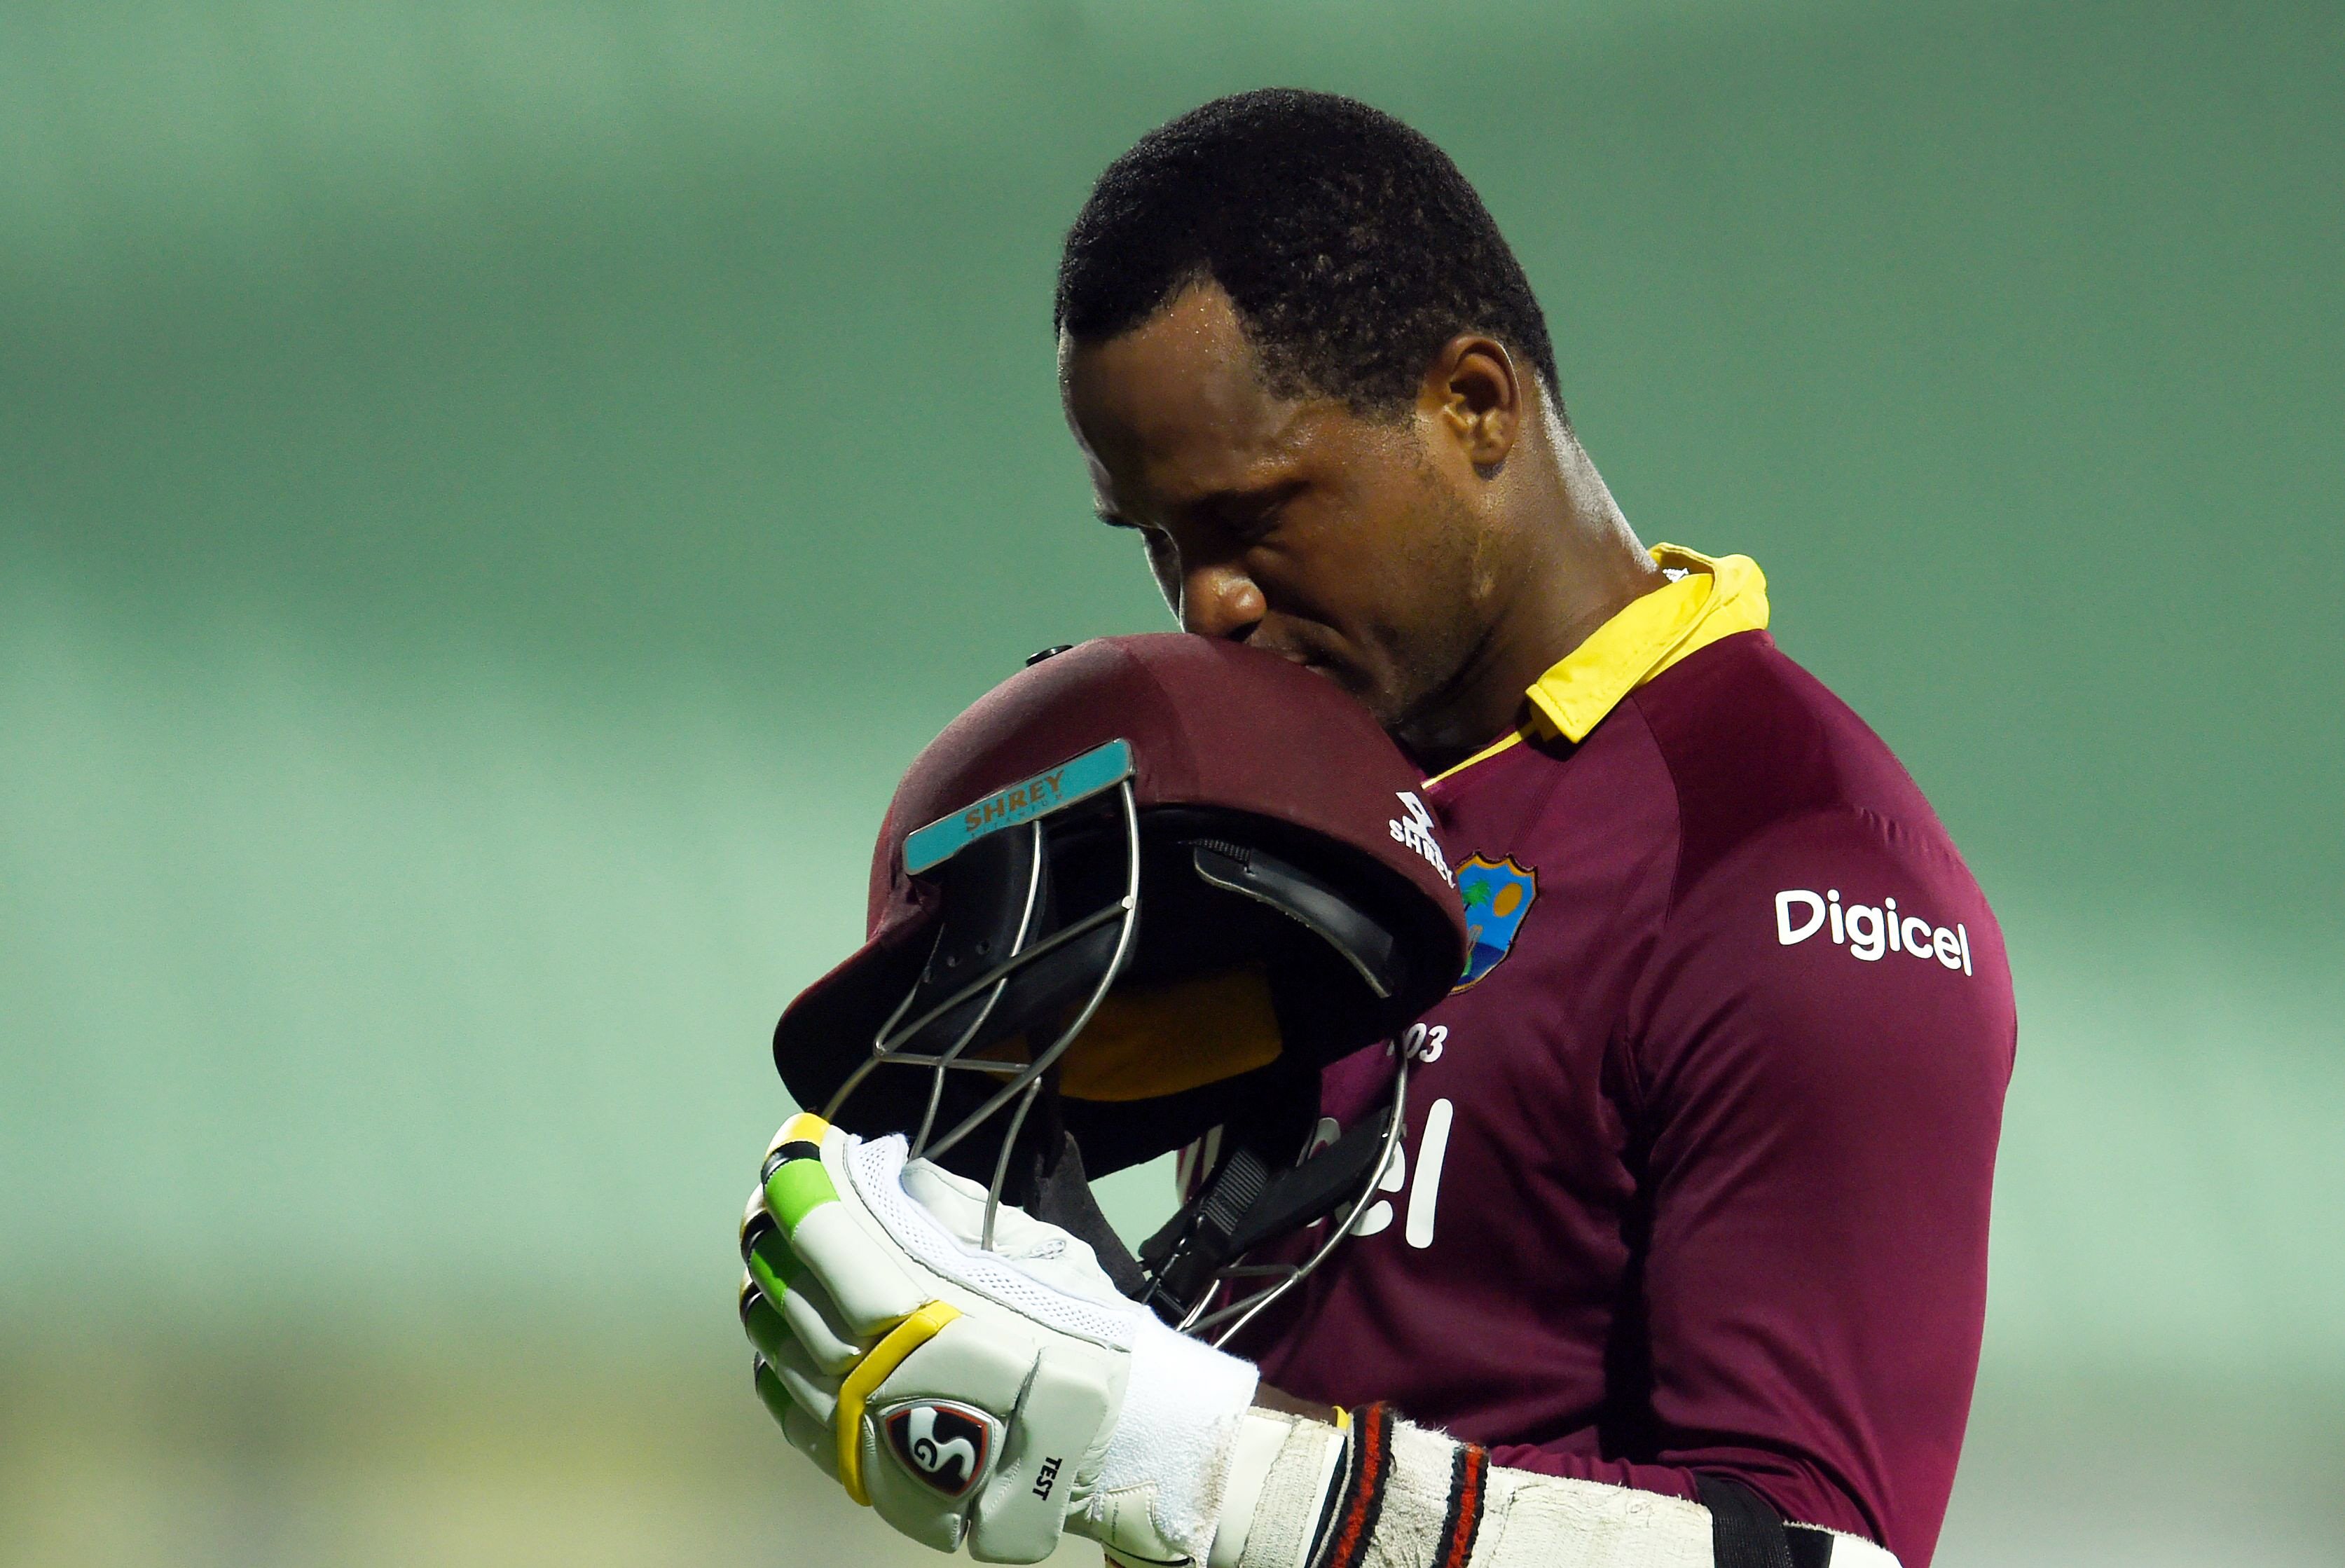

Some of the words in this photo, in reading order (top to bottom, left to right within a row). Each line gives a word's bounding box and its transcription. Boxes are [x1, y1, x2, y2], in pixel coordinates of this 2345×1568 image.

[965, 769, 1064, 832] SHREY
[1389, 818, 1456, 889] SHREY
[1775, 888, 1973, 977] Digicel
[1387, 1022, 1448, 1063] 03
[1032, 1457, 1063, 1501] TEST
